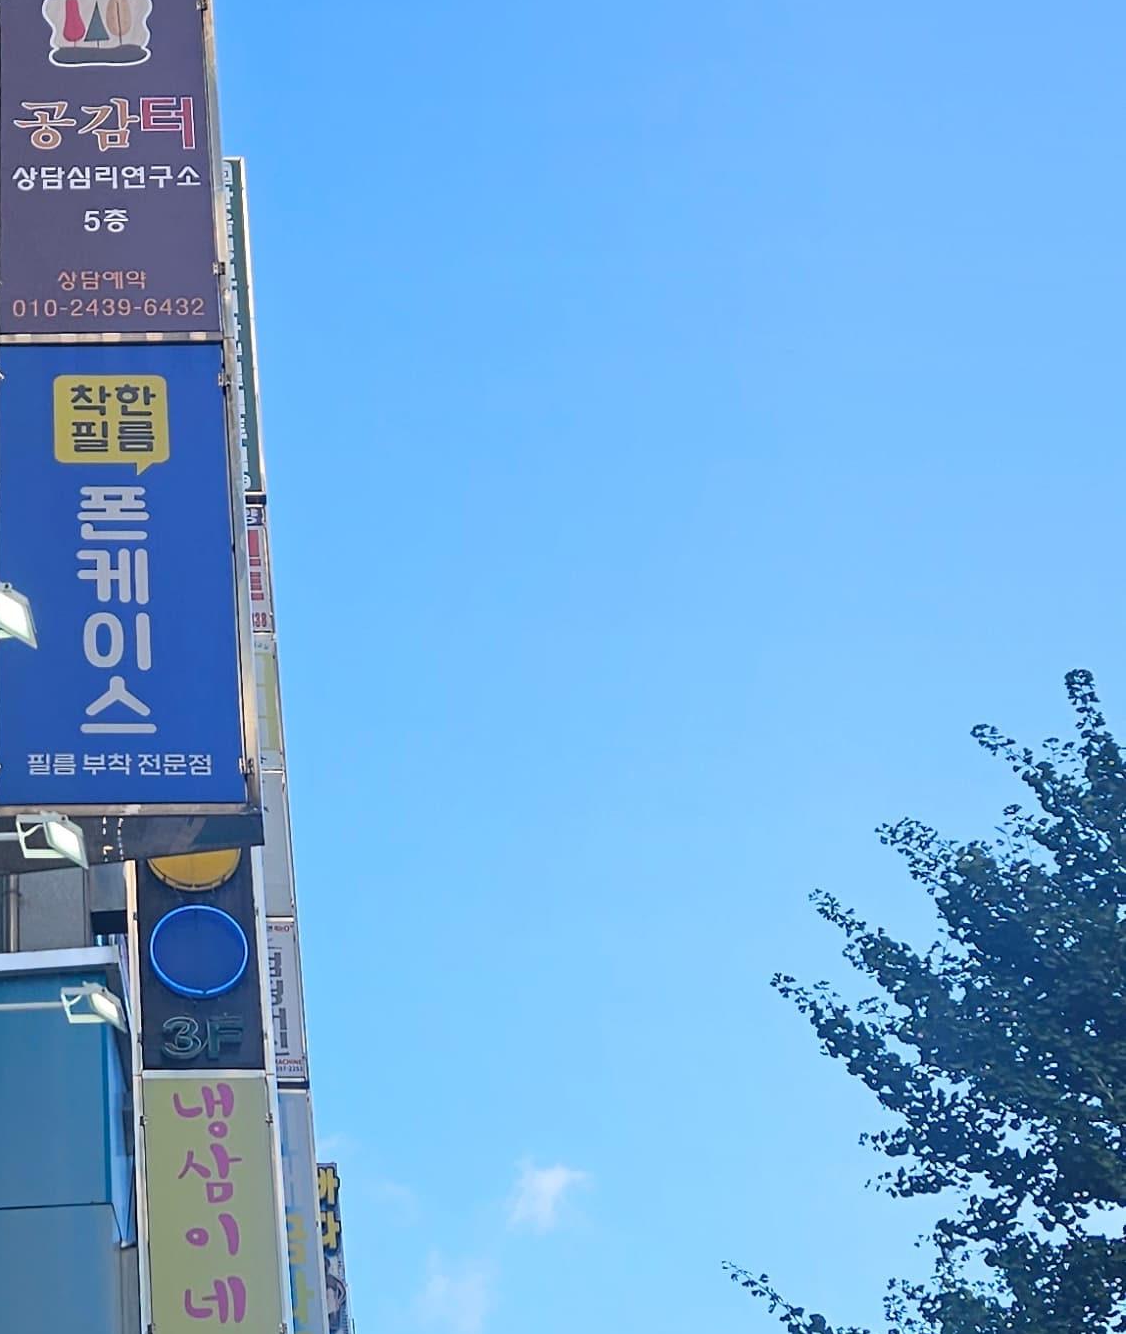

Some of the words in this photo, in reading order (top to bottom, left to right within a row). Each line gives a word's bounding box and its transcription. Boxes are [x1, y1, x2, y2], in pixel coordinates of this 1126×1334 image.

[13, 97, 196, 152] 공감터
[11, 165, 202, 191] 상담심리연구소
[83, 209, 130, 234] 5층
[57, 269, 147, 291] 상담예약
[12, 297, 206, 319] 010-2439-6432
[70, 382, 157, 417] 착한
[71, 420, 156, 454] 필름
[76, 485, 158, 735] 폰케이스
[26, 752, 78, 777] 필름
[81, 752, 133, 777] 부착
[136, 752, 213, 777] 전문점
[160, 1014, 244, 1061] 3F
[173, 1082, 248, 1325] 냉삼이네
